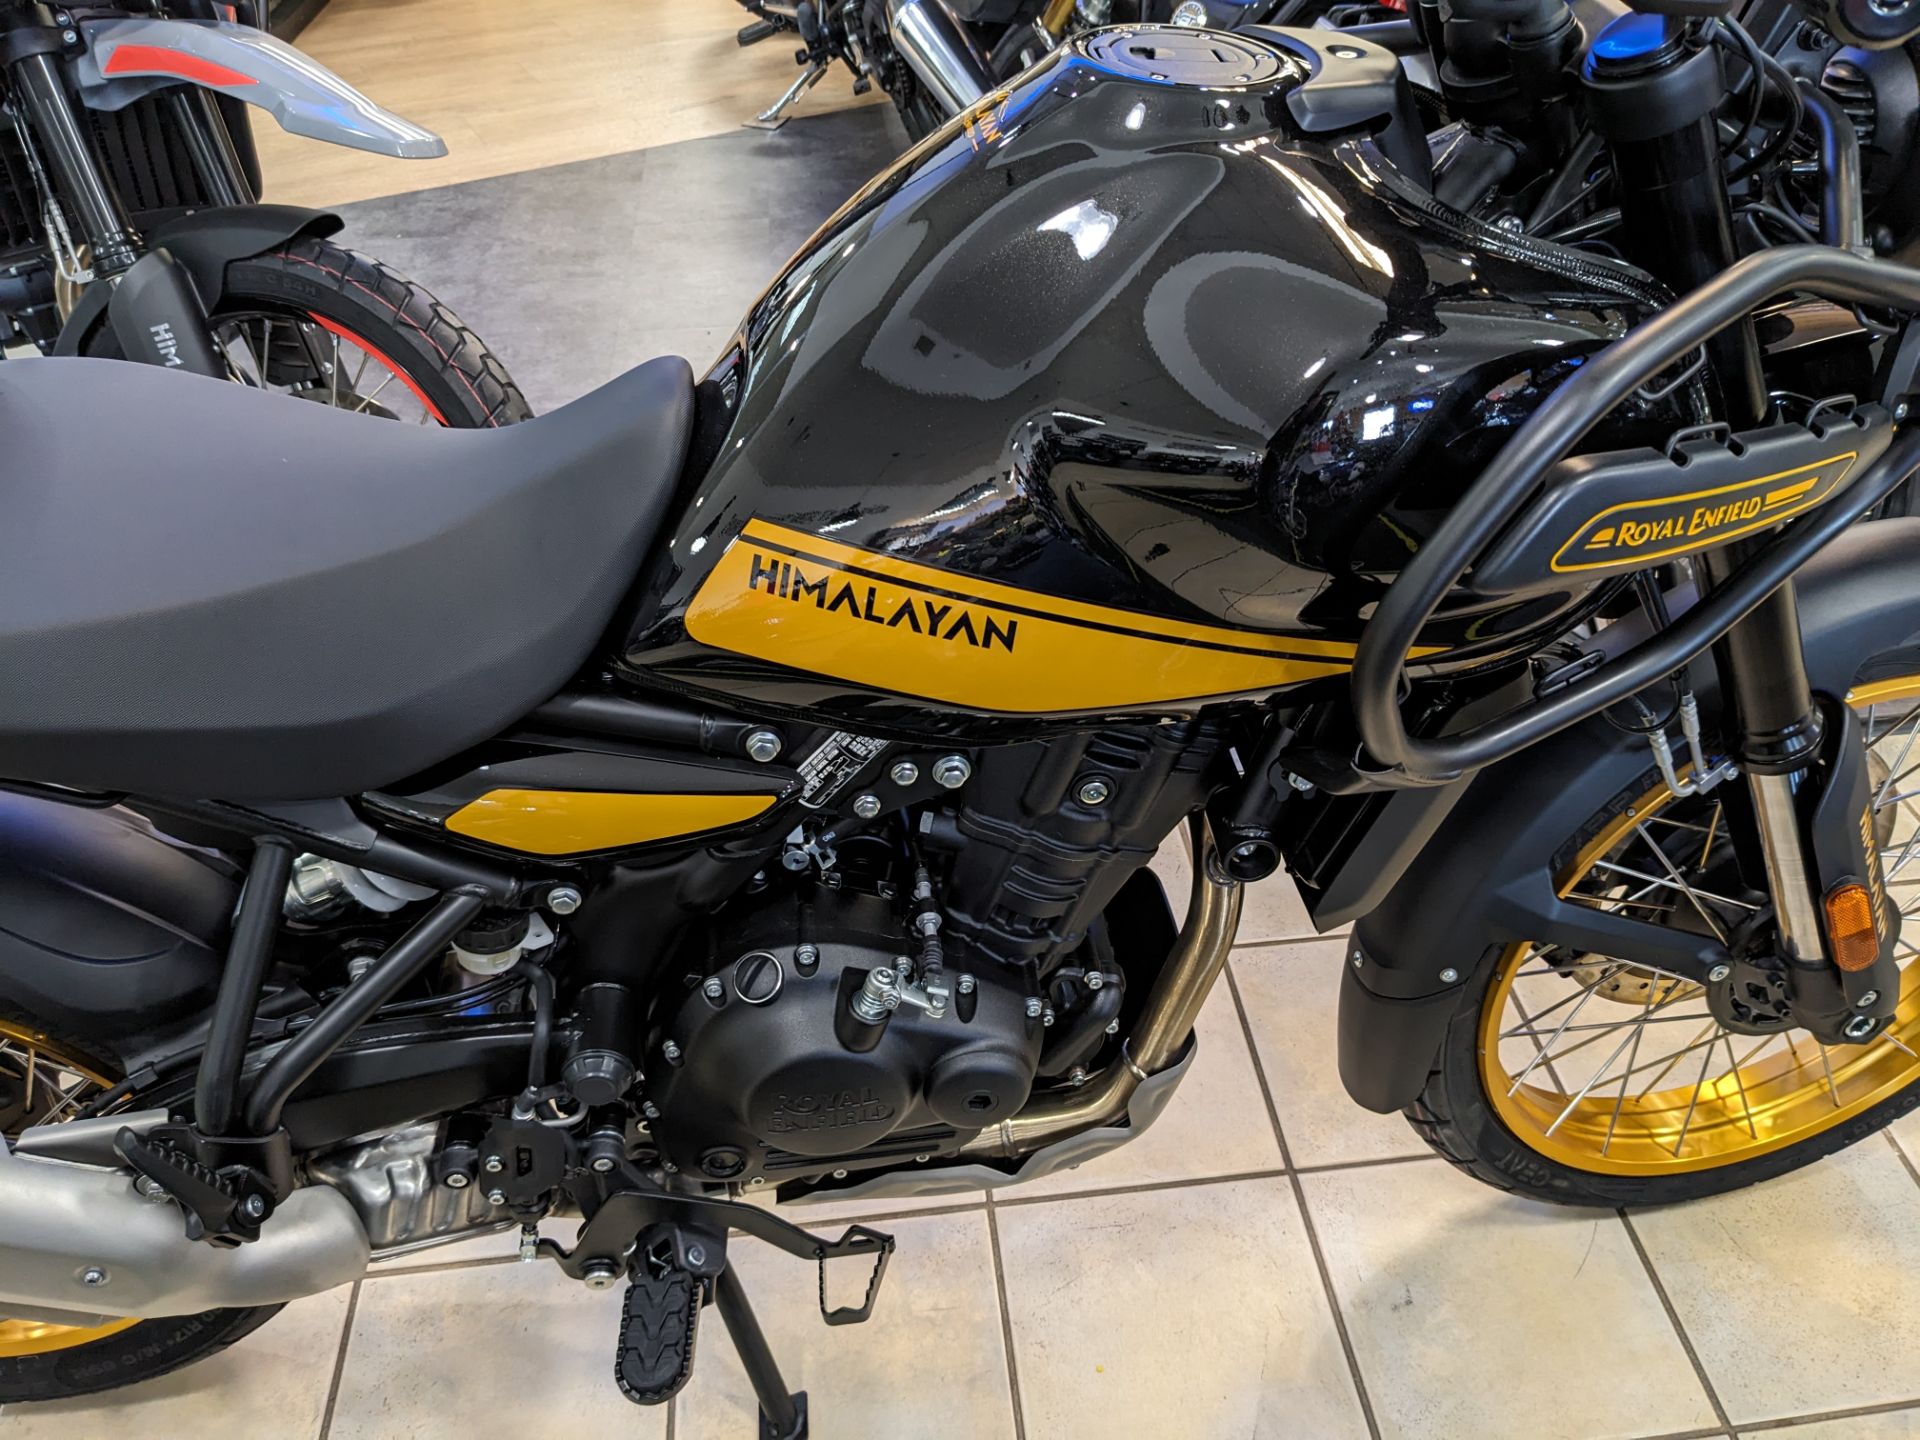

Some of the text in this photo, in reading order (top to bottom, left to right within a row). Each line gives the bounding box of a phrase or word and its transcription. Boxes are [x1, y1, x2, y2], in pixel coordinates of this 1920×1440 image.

[150, 323, 185, 367] HIM
[1616, 496, 1761, 548] ROYAL ENFIELD
[748, 553, 1018, 654] HIMALAYAN
[767, 1104, 896, 1135] ENFIELD
[772, 1087, 880, 1115] ROYAL
